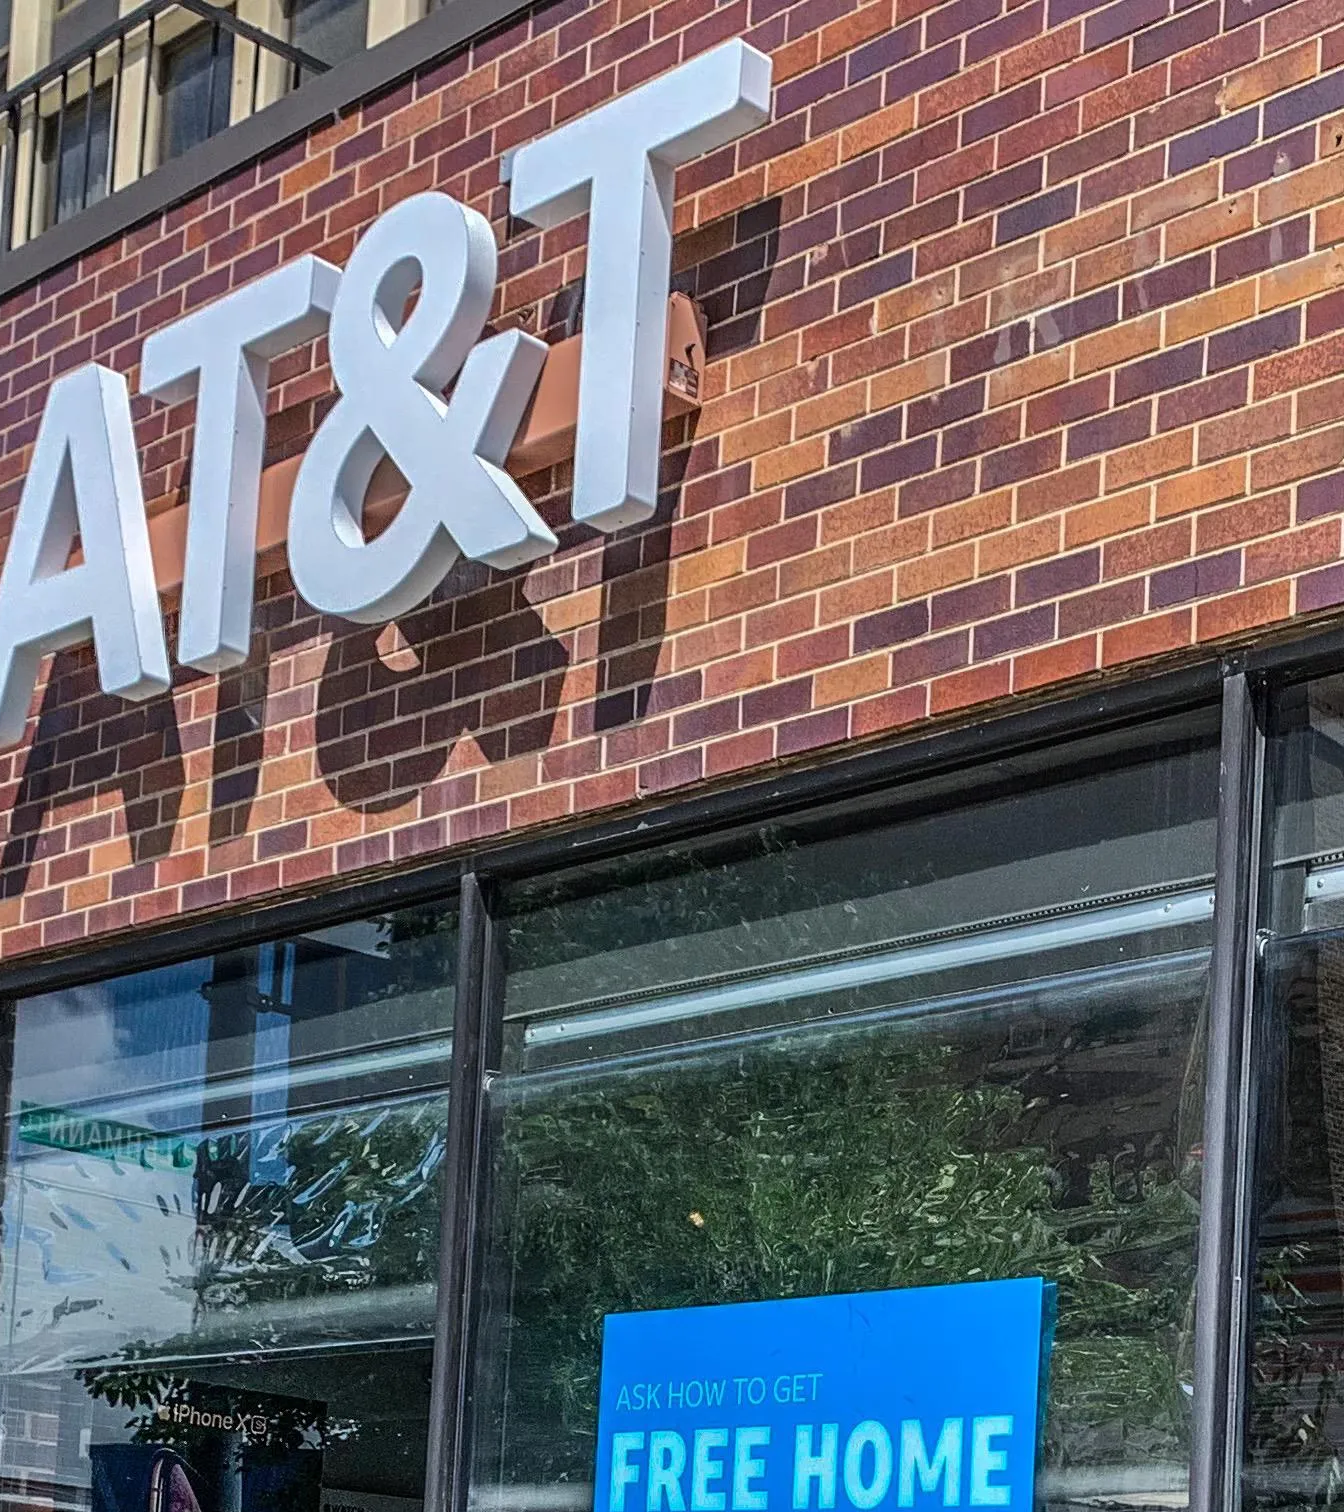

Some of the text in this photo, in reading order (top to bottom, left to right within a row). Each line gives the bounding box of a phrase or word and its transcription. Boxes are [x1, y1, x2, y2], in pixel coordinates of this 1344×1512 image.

[615, 1373, 824, 1411] ASK HOW TO GET
[172, 1403, 233, 1431] iPhone
[608, 1414, 1015, 1512] FREE HOME
